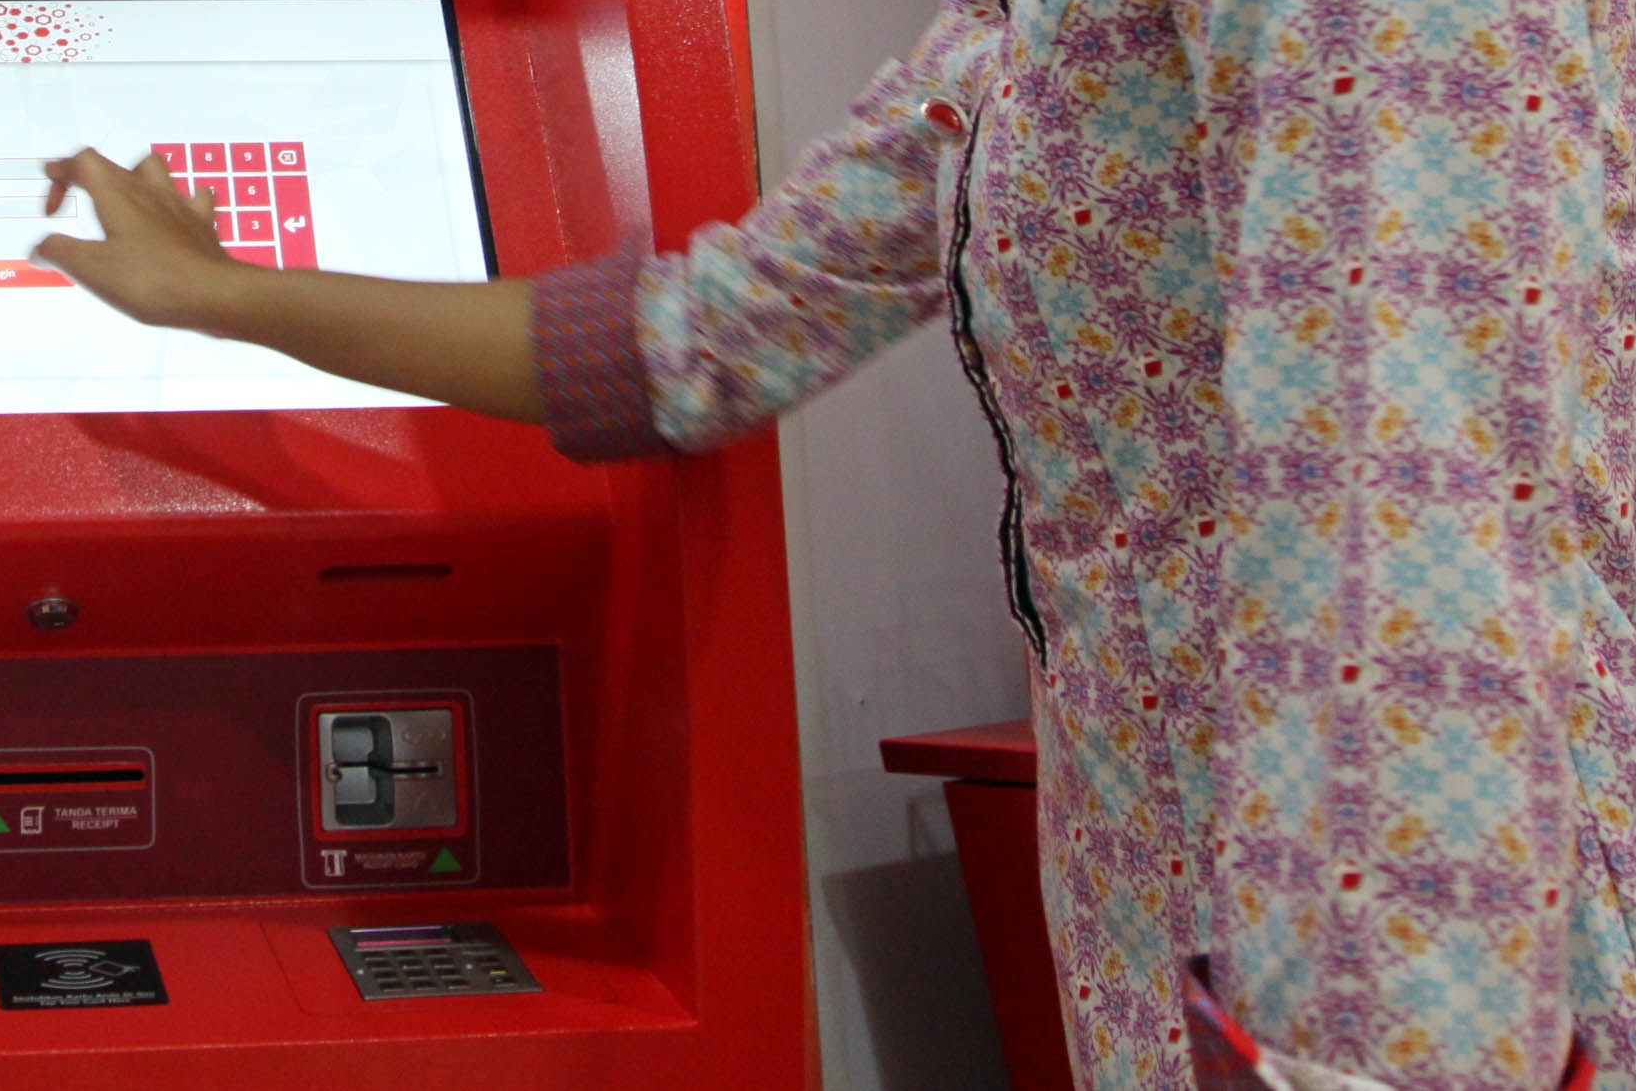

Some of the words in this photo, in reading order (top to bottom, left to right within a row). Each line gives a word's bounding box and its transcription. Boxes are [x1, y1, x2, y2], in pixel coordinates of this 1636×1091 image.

[165, 152, 173, 162] 7
[205, 152, 213, 162] 8
[244, 152, 252, 162] 9
[247, 185, 256, 196] 6
[251, 220, 260, 230] 3
[55, 808, 93, 817] TANDA
[95, 806, 137, 816] TERIMA
[71, 819, 120, 830] RECEIPT
